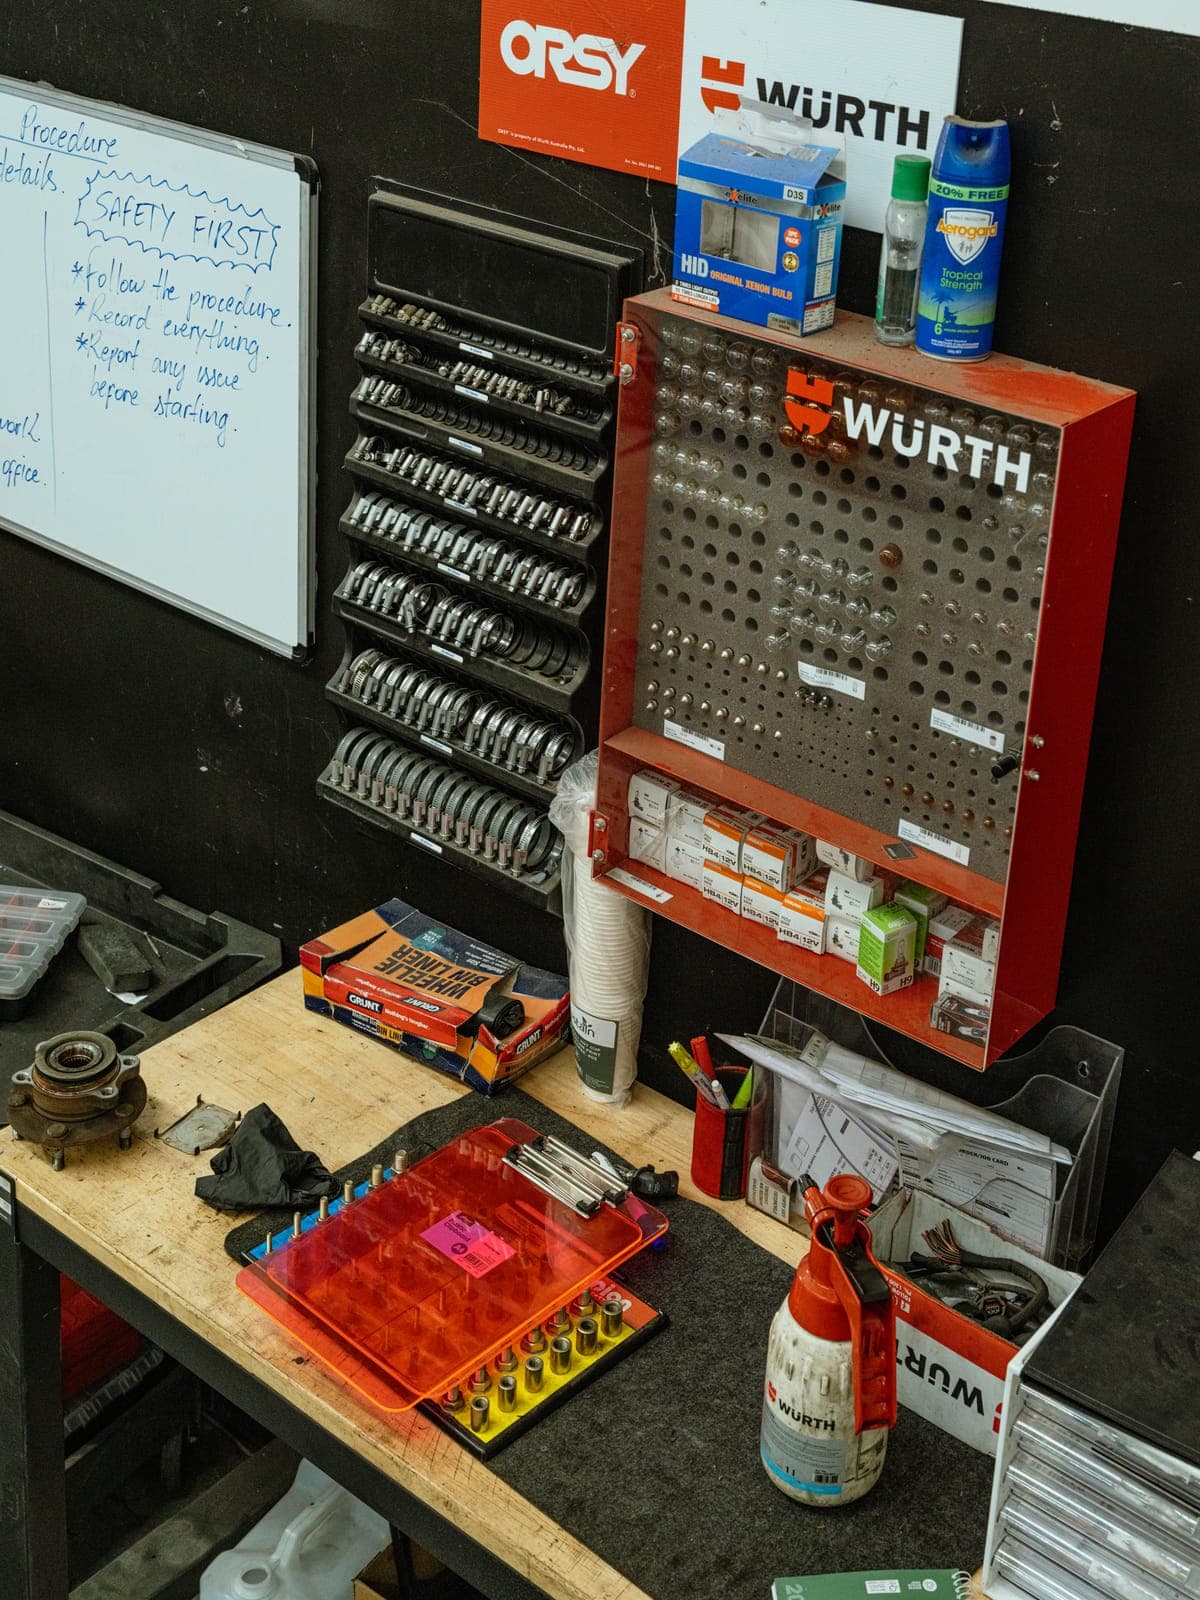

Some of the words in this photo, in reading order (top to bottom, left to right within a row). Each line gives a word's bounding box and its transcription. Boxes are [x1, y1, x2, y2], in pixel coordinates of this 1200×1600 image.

[500, 19, 647, 97] ORSY
[20, 105, 120, 157] Procedure
[786, 188, 805, 201] D3S
[936, 184, 964, 198] 20%
[968, 189, 1004, 200] FREE
[93, 190, 176, 241] SAFETY
[936, 218, 998, 240] Aerogard
[681, 253, 710, 278] HID
[942, 267, 983, 281] Tropical
[709, 271, 744, 289] ORIGINAL
[744, 279, 771, 295] XENON
[772, 287, 793, 301] BULB
[940, 278, 983, 292] Strength
[152, 268, 180, 302] the
[188, 286, 292, 329] procedure.
[88, 293, 151, 331] Record
[163, 318, 270, 374] everything.
[934, 322, 943, 336] 6
[86, 328, 141, 373] Report
[151, 357, 187, 391] any
[90, 365, 140, 410] before
[154, 388, 238, 448] starting.
[2, 455, 47, 487] office.
[721, 855, 737, 867] 12V
[764, 874, 780, 885] 12V
[779, 927, 800, 940] HB4
[802, 935, 820, 947] 12V
[391, 944, 454, 976] LINER
[373, 957, 472, 1000] WHEELIE
[447, 969, 491, 986] BIN
[870, 978, 881, 992] H9
[900, 974, 913, 987] H9
[348, 993, 382, 1013] GRUNT
[403, 997, 441, 1013] GRUNT
[515, 1028, 542, 1055] GRUNT
[896, 1338, 985, 1416] WÜR
